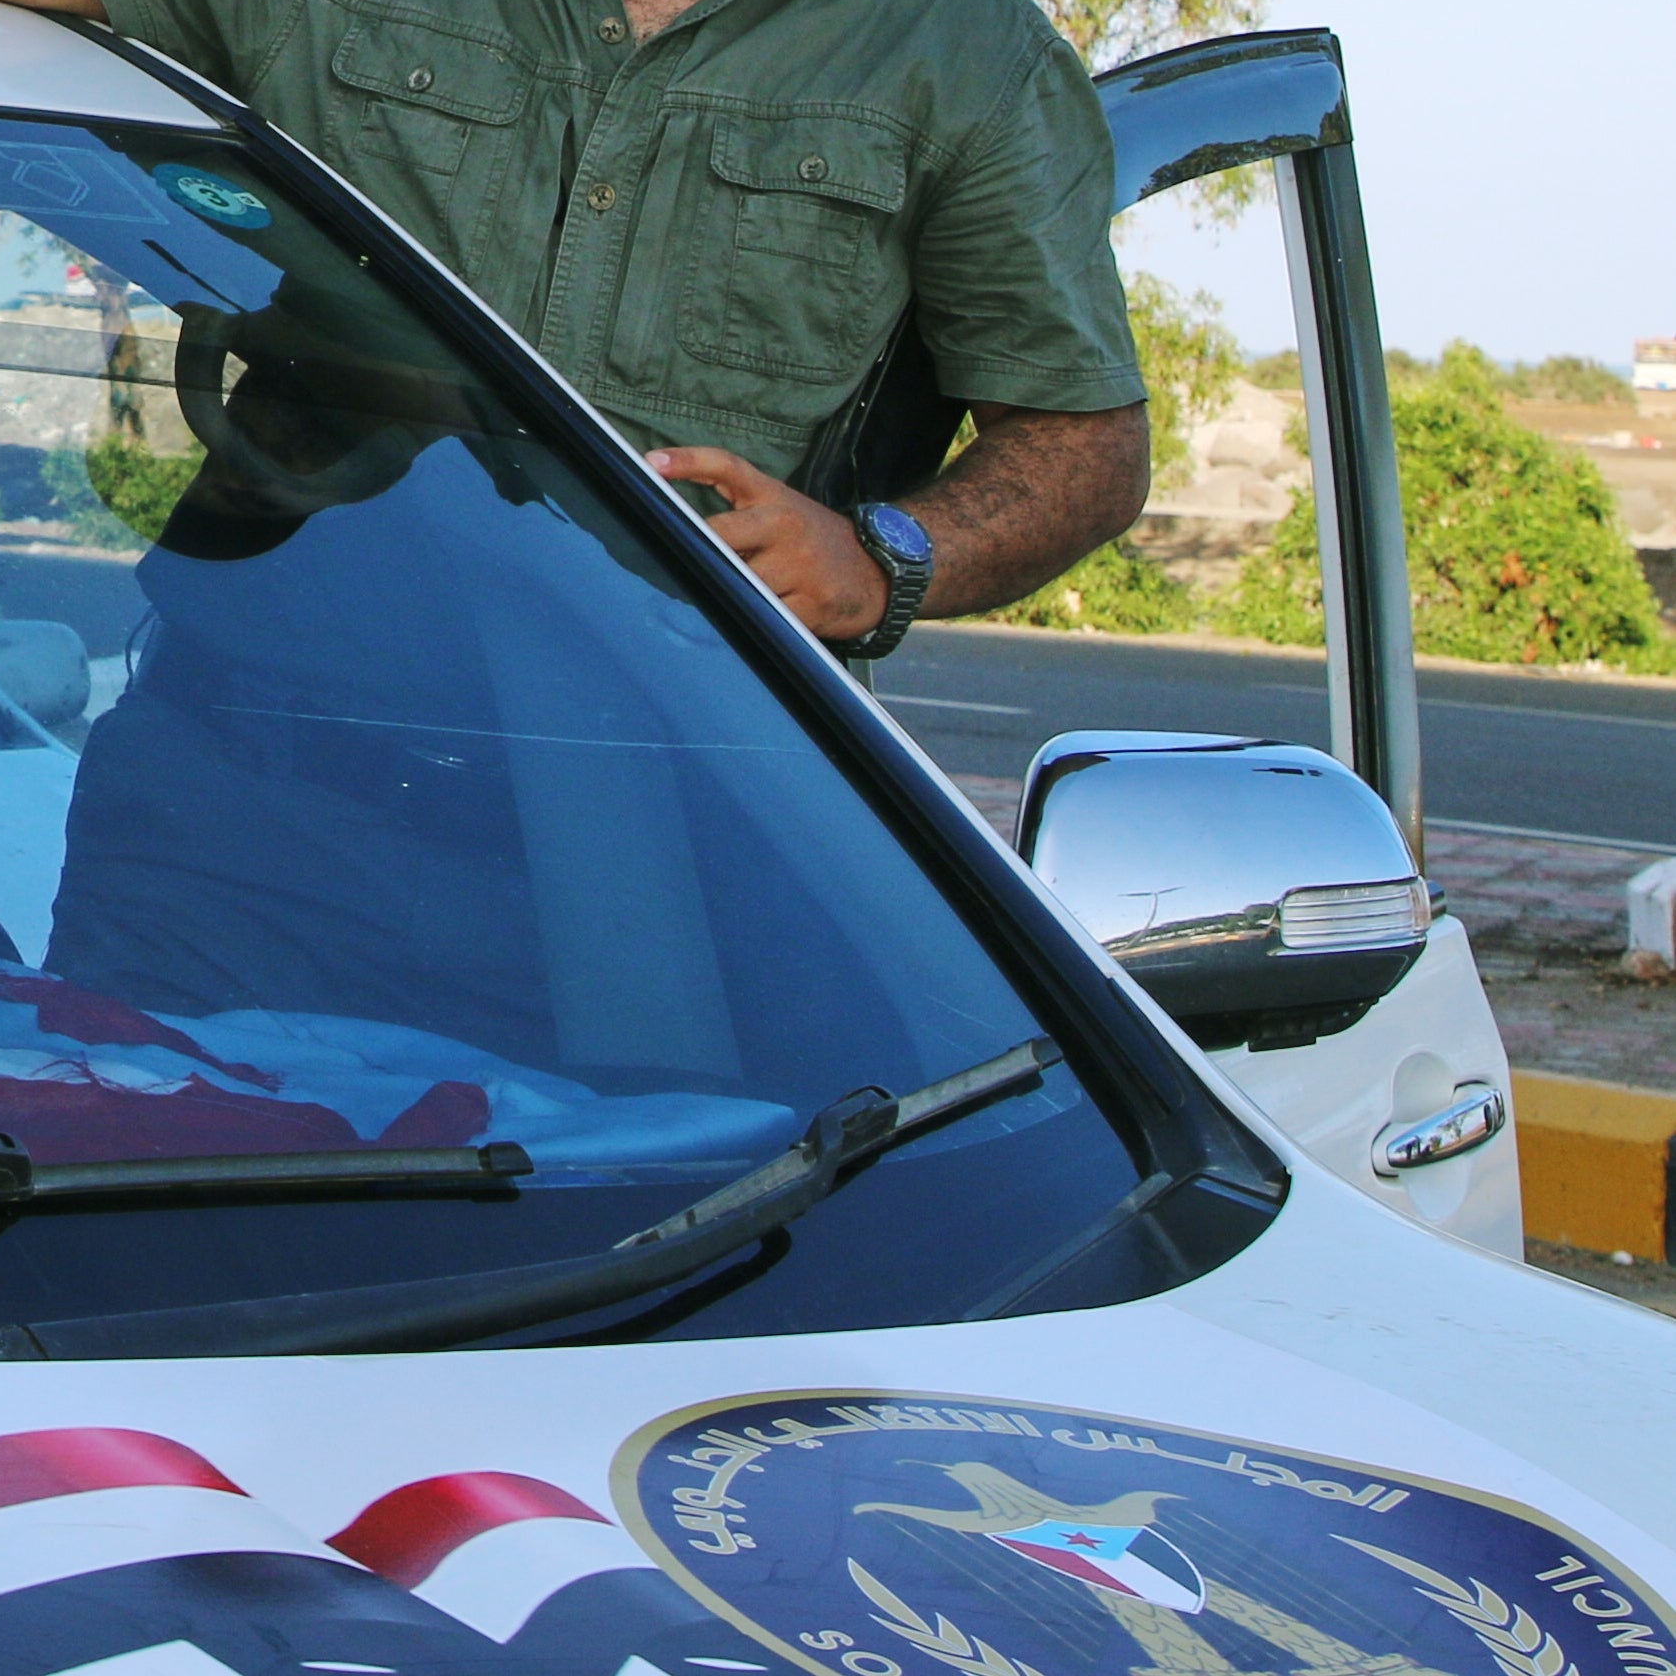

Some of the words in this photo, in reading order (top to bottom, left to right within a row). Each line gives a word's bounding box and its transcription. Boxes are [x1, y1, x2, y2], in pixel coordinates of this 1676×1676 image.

[746, 1403, 1044, 1450] الانتقالي
[1051, 1426, 1411, 1513] المجلس
[668, 1428, 771, 1555] الجنوبي
[1535, 1555, 1676, 1676] UNCIL
